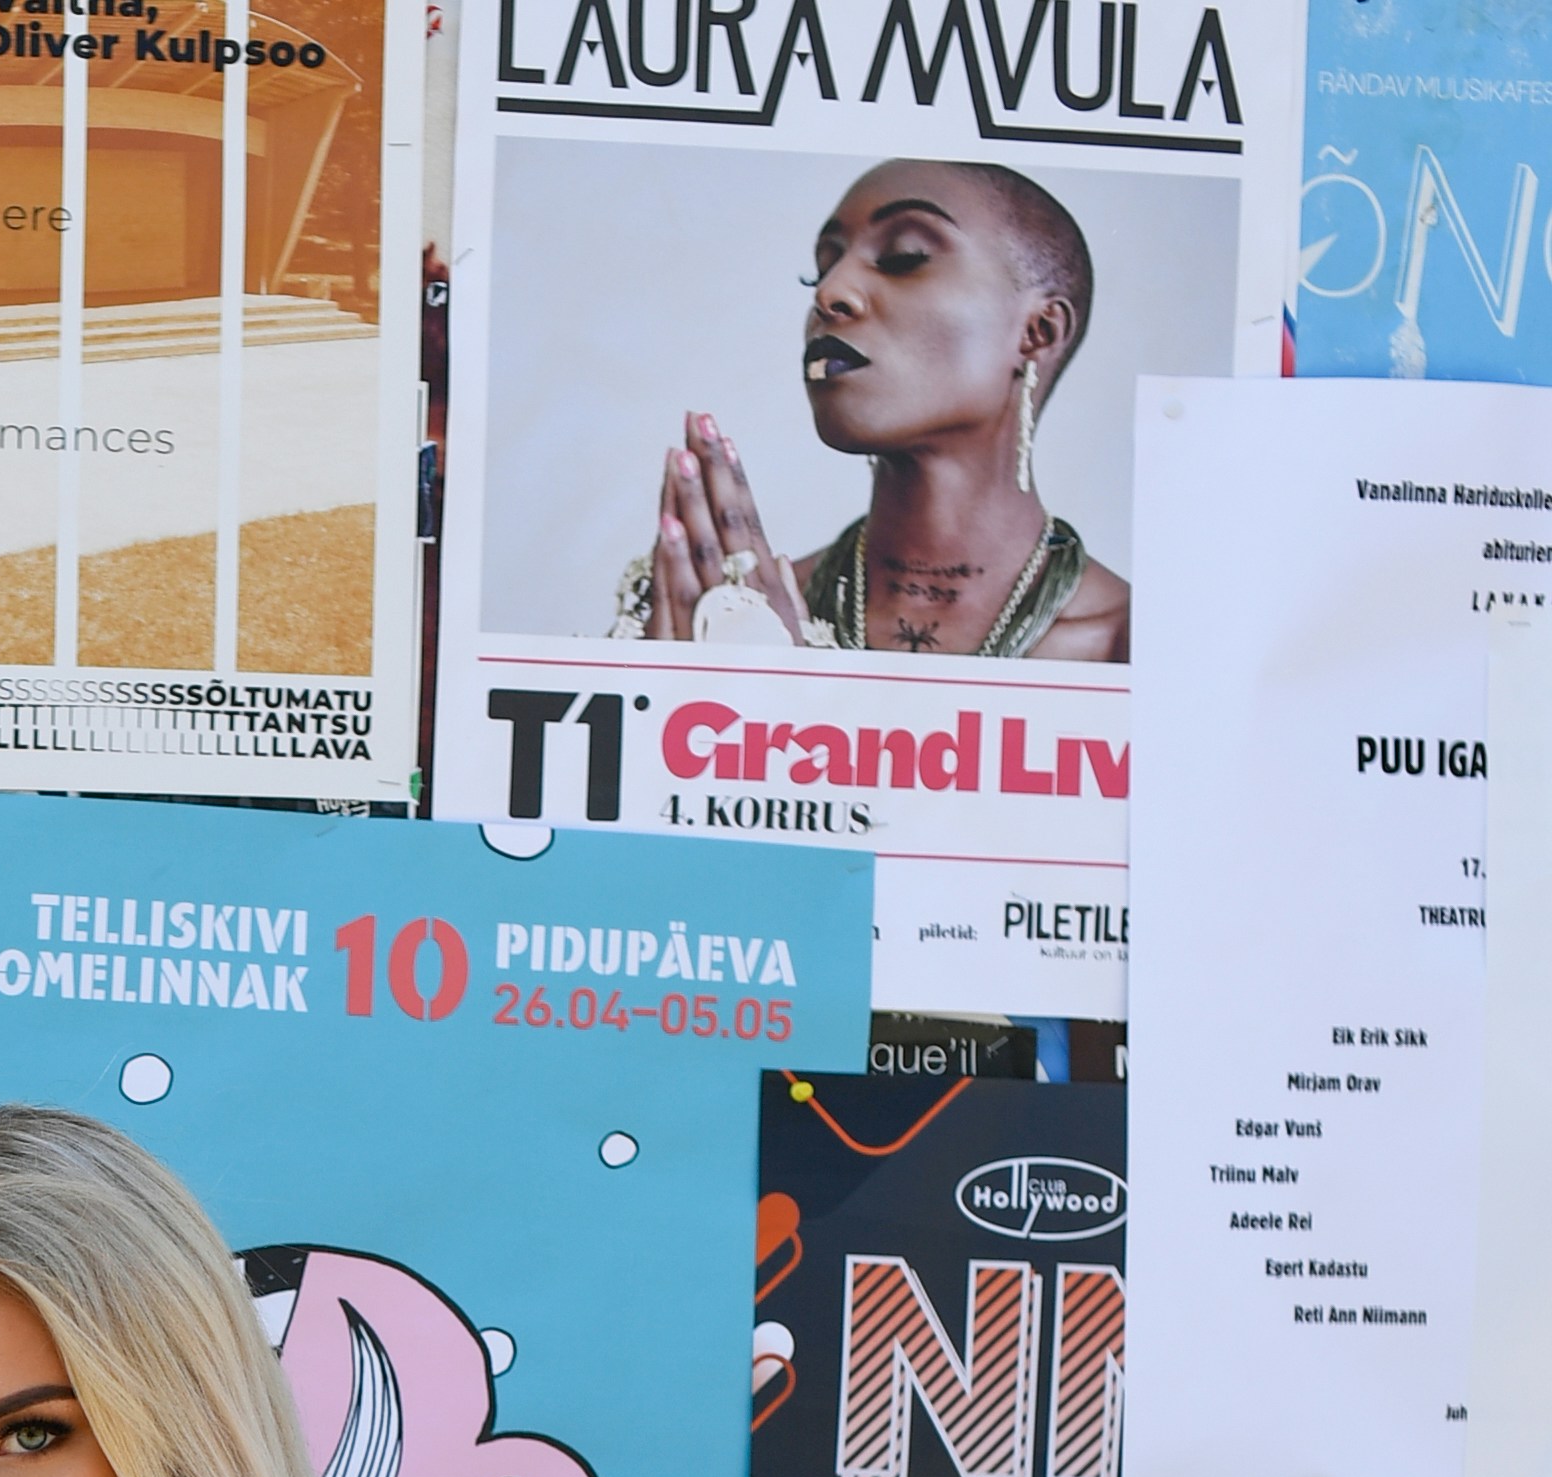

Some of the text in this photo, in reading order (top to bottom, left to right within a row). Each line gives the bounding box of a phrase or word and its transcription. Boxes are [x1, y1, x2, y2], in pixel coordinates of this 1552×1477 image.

[136, 30, 326, 72] Kulpsoo
[497, 0, 1244, 126] LAURA MVULA
[1317, 66, 1413, 98] RÄNDAV
[1355, 478, 1448, 505] Vanalinna
[487, 688, 624, 822] T1
[661, 700, 982, 794] Grand
[1355, 735, 1488, 780] PUU IGA
[658, 794, 872, 835] 4. KORRUS
[31, 892, 309, 957] TELLISKIVI
[918, 923, 979, 943] piletid:
[494, 919, 798, 988] PIDUPÄEVA
[334, 913, 469, 1022] 10
[1331, 1026, 1429, 1047] Eik Erik Sikk
[1287, 1071, 1382, 1093] Mirjam Orav
[1235, 1118, 1280, 1140] Edgar
[1028, 1177, 1067, 1193] CLUB
[1209, 1164, 1299, 1184] Triinu Malv
[1229, 1211, 1313, 1231] Adeele Rei
[1265, 1258, 1369, 1279] Egert Kadastu
[1294, 1305, 1428, 1326] Reti Ann Niimann
